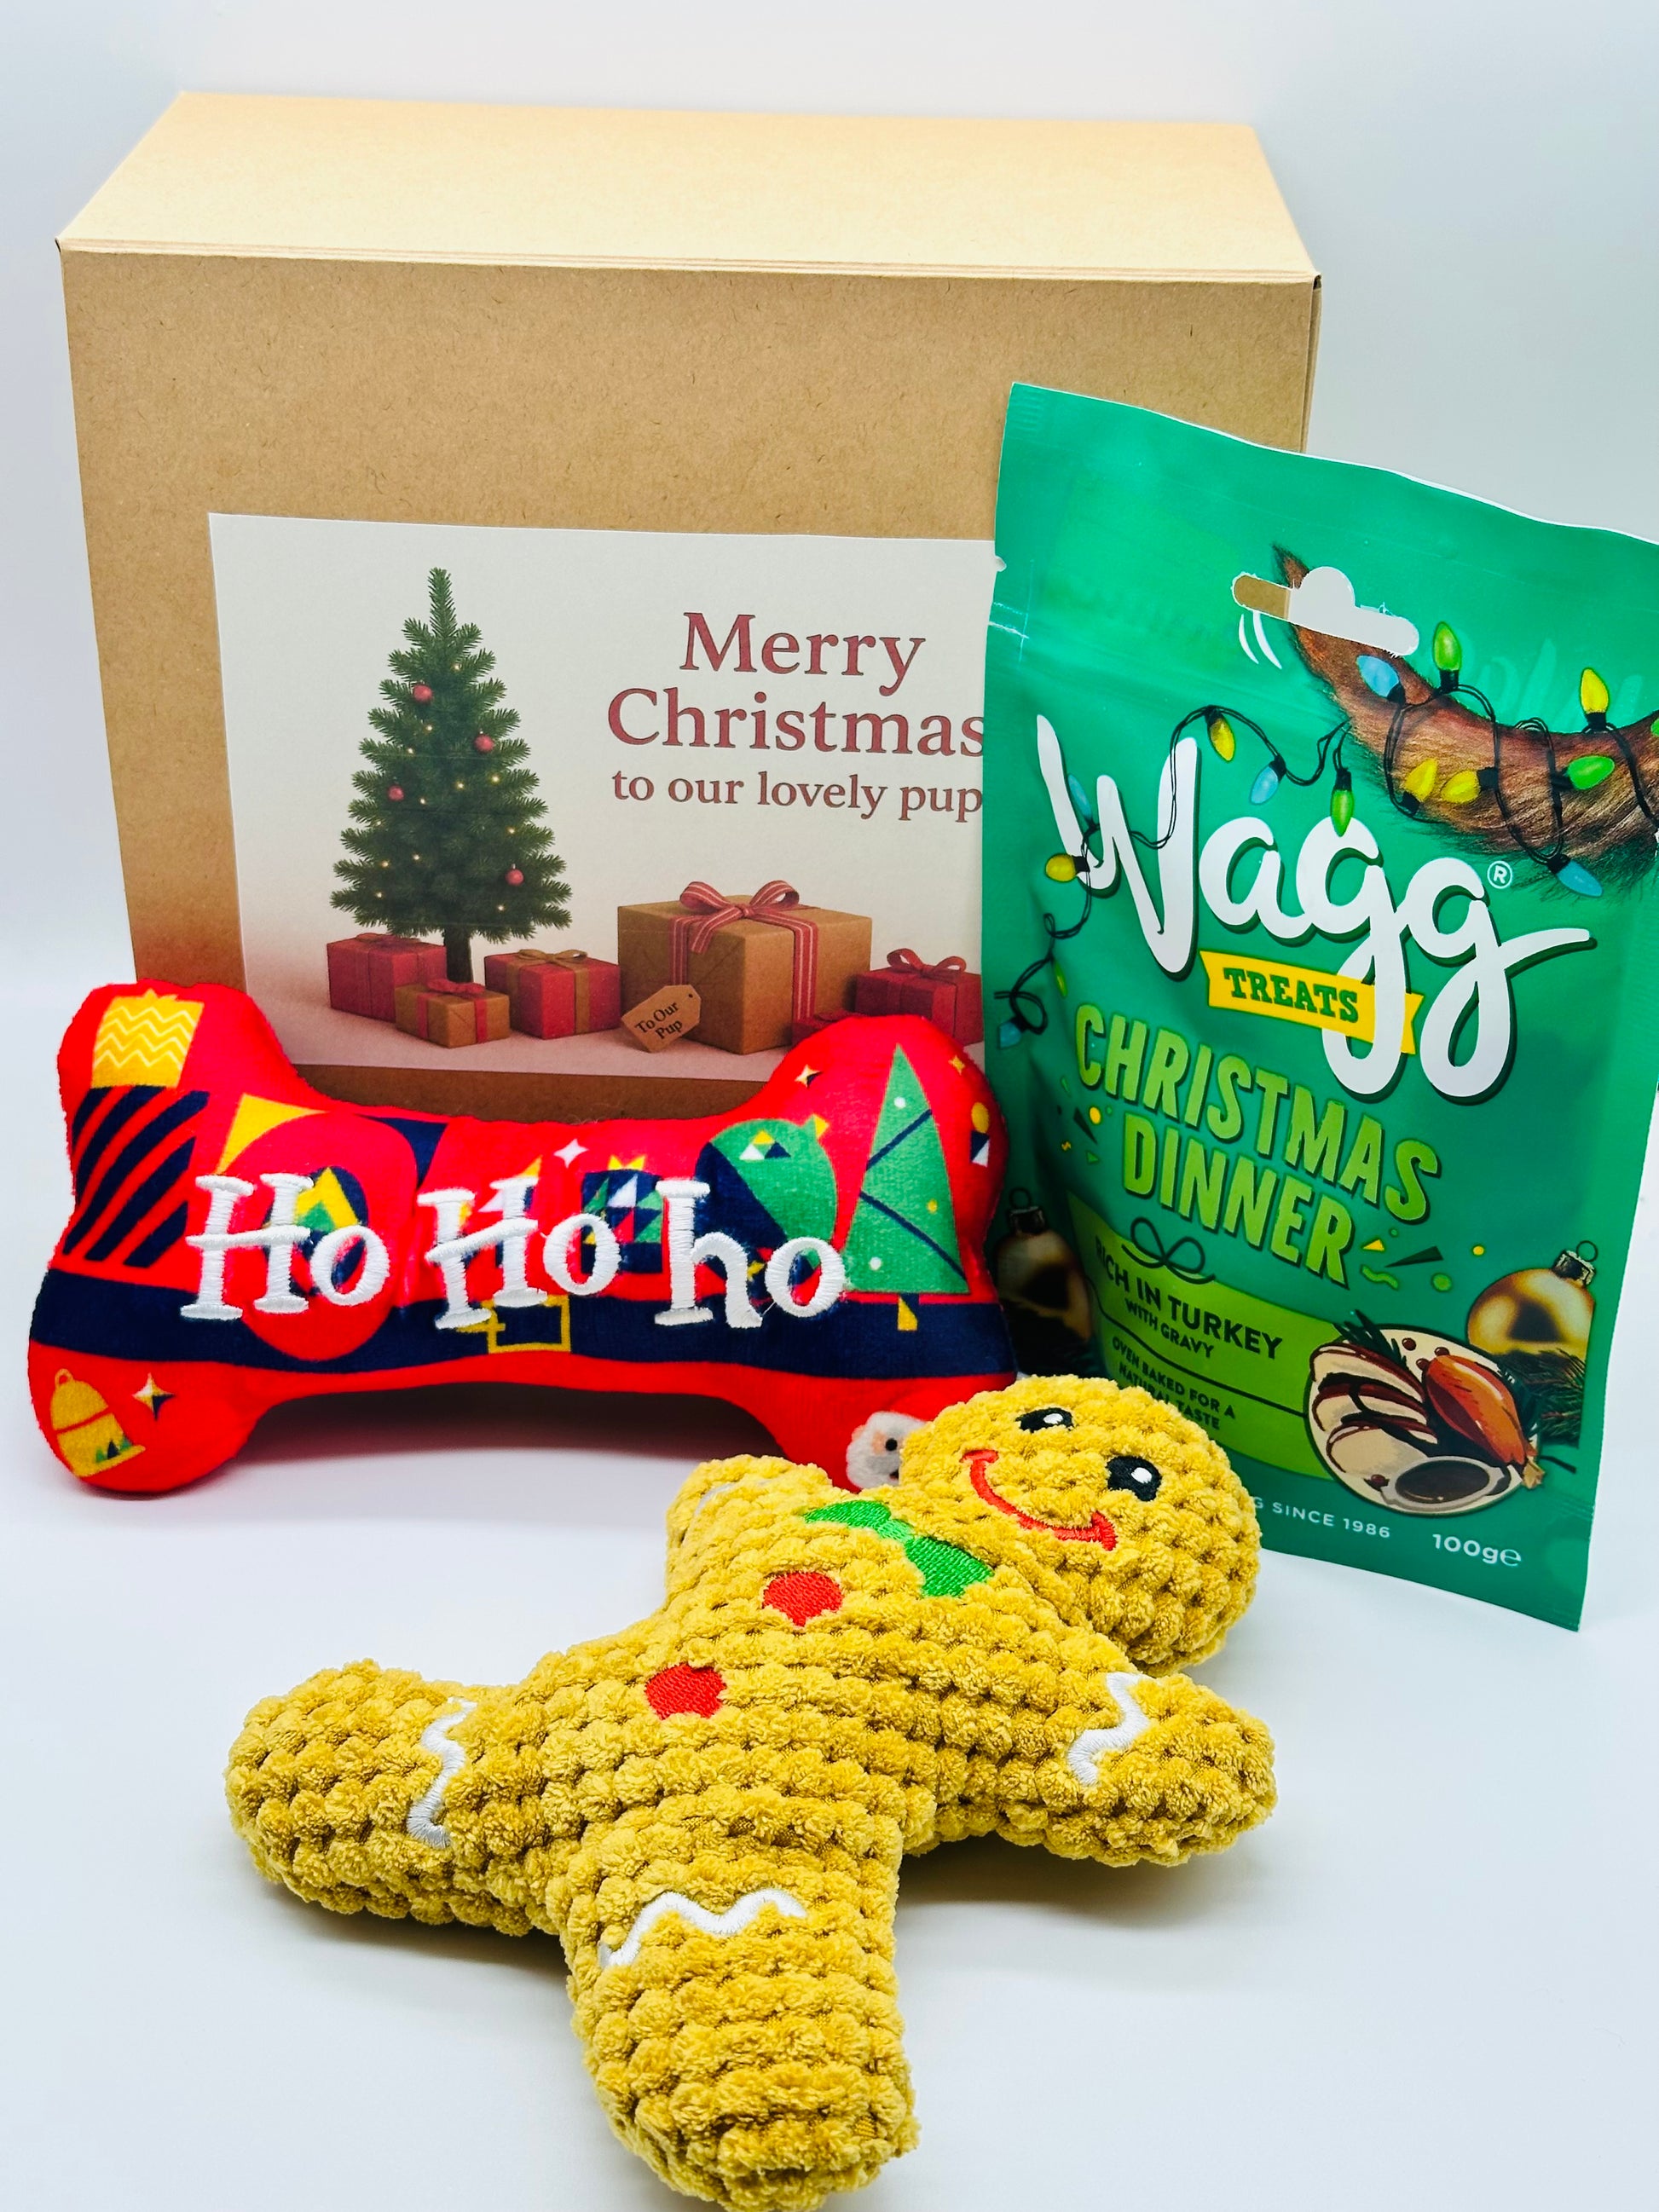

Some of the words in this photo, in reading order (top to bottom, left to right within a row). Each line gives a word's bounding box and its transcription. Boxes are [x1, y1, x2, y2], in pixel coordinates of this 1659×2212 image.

[679, 611, 926, 696] Merry
[608, 687, 984, 757] Christmas
[612, 770, 655, 802] to
[668, 777, 744, 805] our
[757, 771, 887, 820] lovely
[899, 784, 983, 823] pup
[634, 1019, 656, 1033] To
[653, 1002, 679, 1022] Our
[1223, 967, 1360, 1023] TREATS
[655, 1019, 683, 1040] Pup
[1075, 1003, 1441, 1224] CHRISTMAS
[1123, 1112, 1352, 1288] DINNER
[180, 1172, 391, 1321] Ho
[417, 1175, 621, 1330] Ho
[653, 1178, 847, 1330] ho
[1095, 1235, 1130, 1292] RICH
[1136, 1276, 1162, 1311] IN
[1167, 1295, 1283, 1360] TURKEY
[1124, 1297, 1159, 1331] WITH
[1159, 1321, 1215, 1359] GRAVY
[1112, 1336, 1140, 1369] OVEN
[1142, 1360, 1185, 1395] BAKED
[1188, 1388, 1221, 1413] FOR
[1223, 1404, 1236, 1419] A
[1176, 1399, 1221, 1430] TASTE
[1271, 1501, 1335, 1528] SINCE
[1343, 1517, 1391, 1539] 1986
